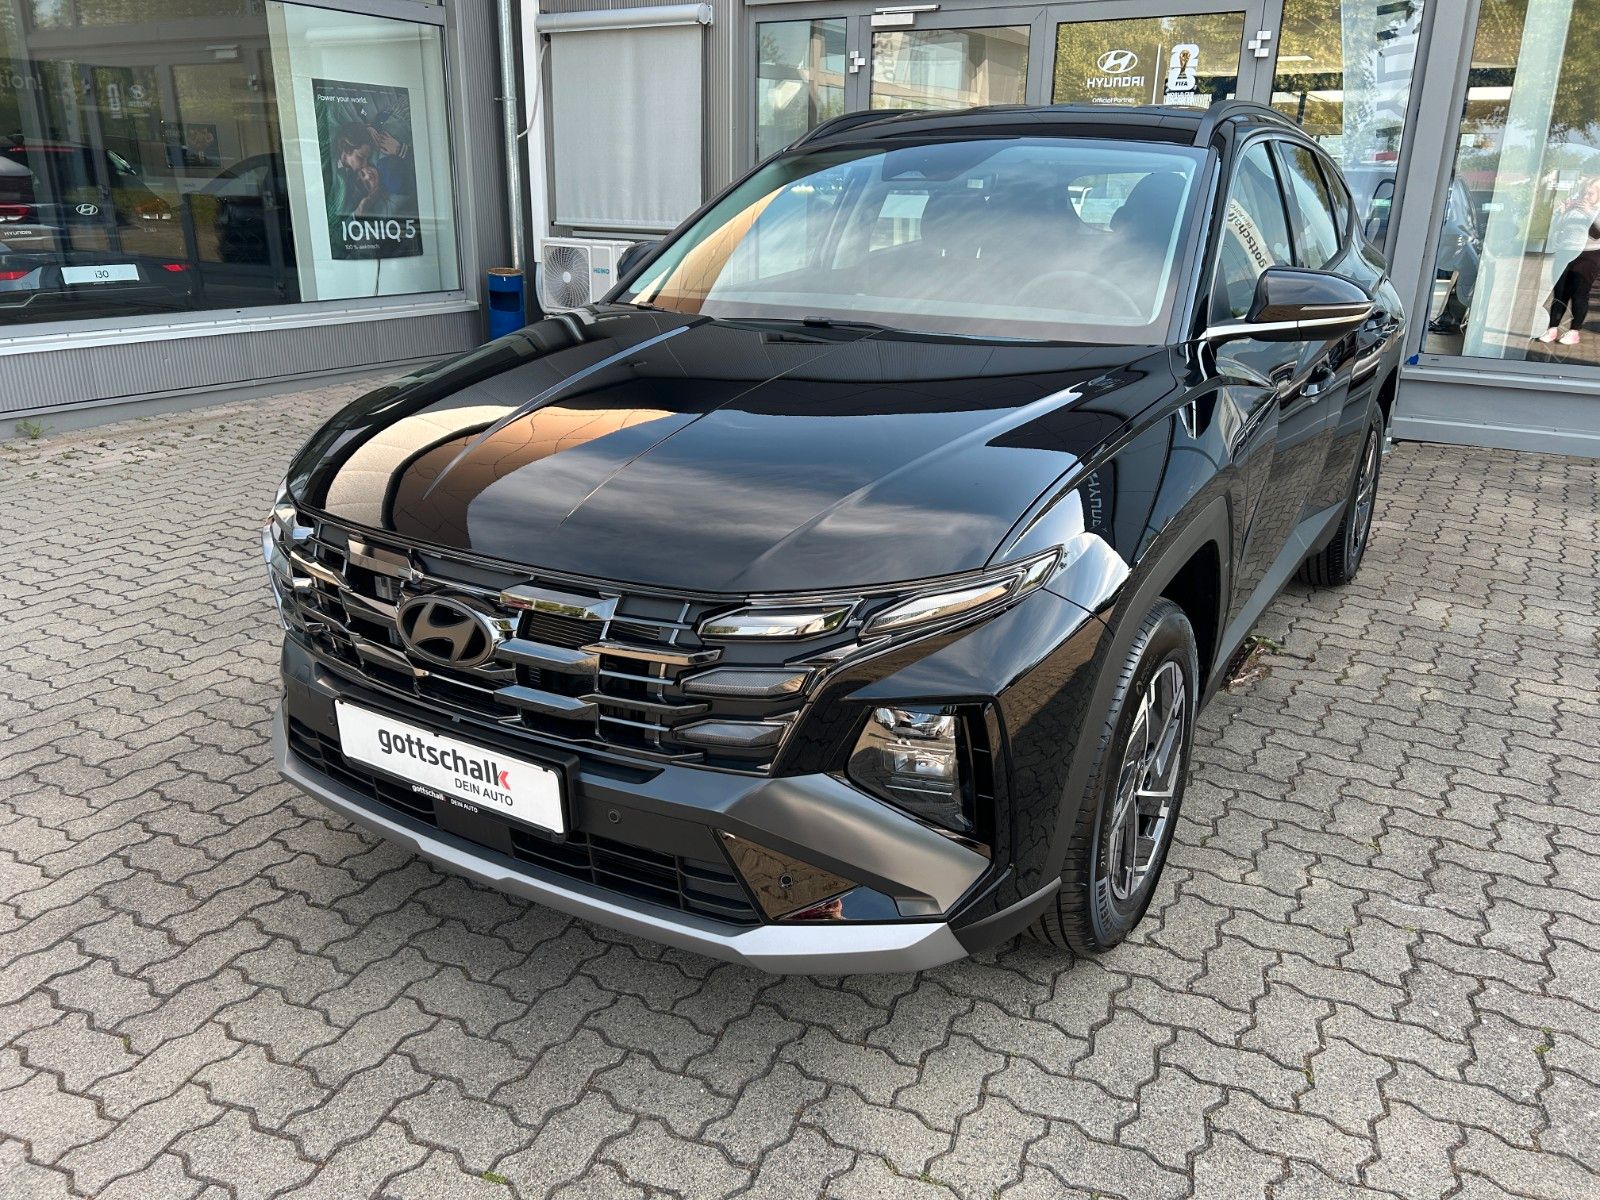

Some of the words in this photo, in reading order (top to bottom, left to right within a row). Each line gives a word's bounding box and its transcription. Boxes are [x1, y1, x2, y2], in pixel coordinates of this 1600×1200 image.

[1087, 76, 1144, 88] HYUNDAI
[317, 93, 335, 102] Power
[1113, 96, 1136, 104] Partner
[341, 219, 402, 242] IONIQ
[405, 219, 417, 239] 5
[94, 270, 109, 278] i30
[378, 728, 511, 790] gottschalk
[411, 784, 447, 802] gottschalk
[450, 798, 463, 809] DEIN
[463, 803, 478, 813] AUTO
[454, 777, 481, 795] DEIN
[482, 787, 514, 807] AUTO
